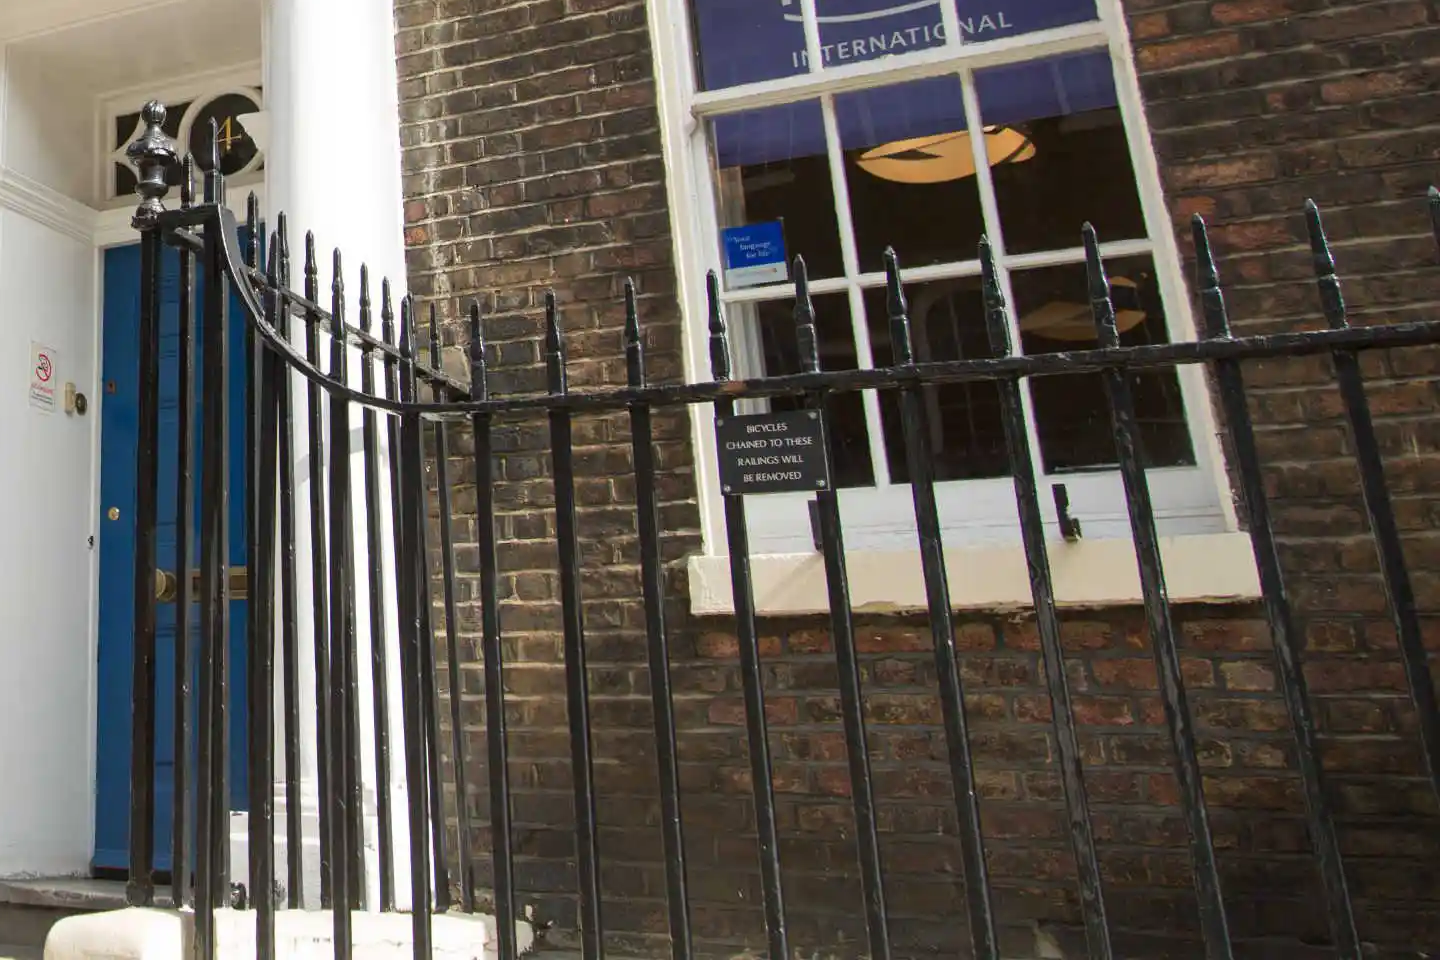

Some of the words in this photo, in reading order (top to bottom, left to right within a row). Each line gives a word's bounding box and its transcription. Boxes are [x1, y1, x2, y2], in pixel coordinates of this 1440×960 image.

[216, 116, 242, 151] 4
[746, 422, 788, 434] BICYCLES
[726, 439, 767, 450] CHAINED
[770, 438, 782, 448] TO
[786, 436, 813, 446] THESE
[737, 456, 780, 467] RAILINGS
[781, 454, 804, 465] WILL
[743, 473, 754, 483] BE
[755, 471, 802, 482] REMOVED
